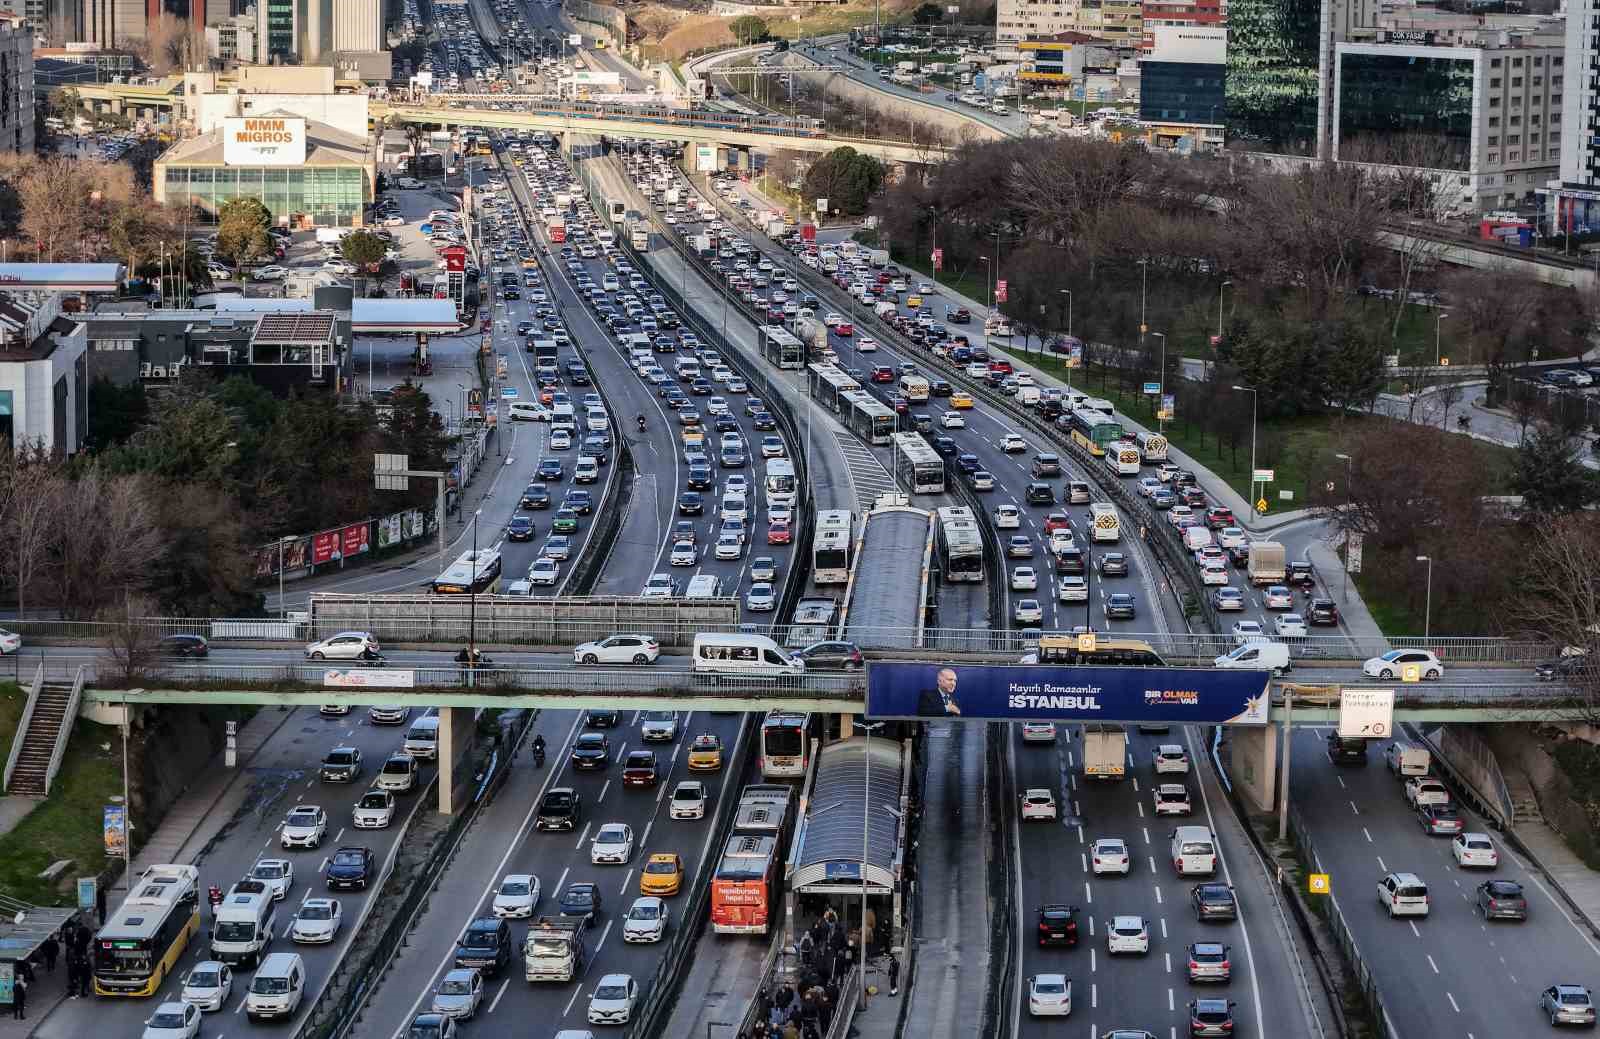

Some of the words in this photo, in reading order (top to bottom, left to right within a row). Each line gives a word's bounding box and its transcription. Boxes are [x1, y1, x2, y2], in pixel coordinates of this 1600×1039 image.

[245, 119, 285, 131] MMM
[236, 131, 293, 143] MIGROS
[1009, 682, 1041, 695] Hayırlı
[1044, 683, 1102, 694] Ramazanlar
[1163, 690, 1199, 699] OLMAK
[1180, 697, 1199, 705] VAR
